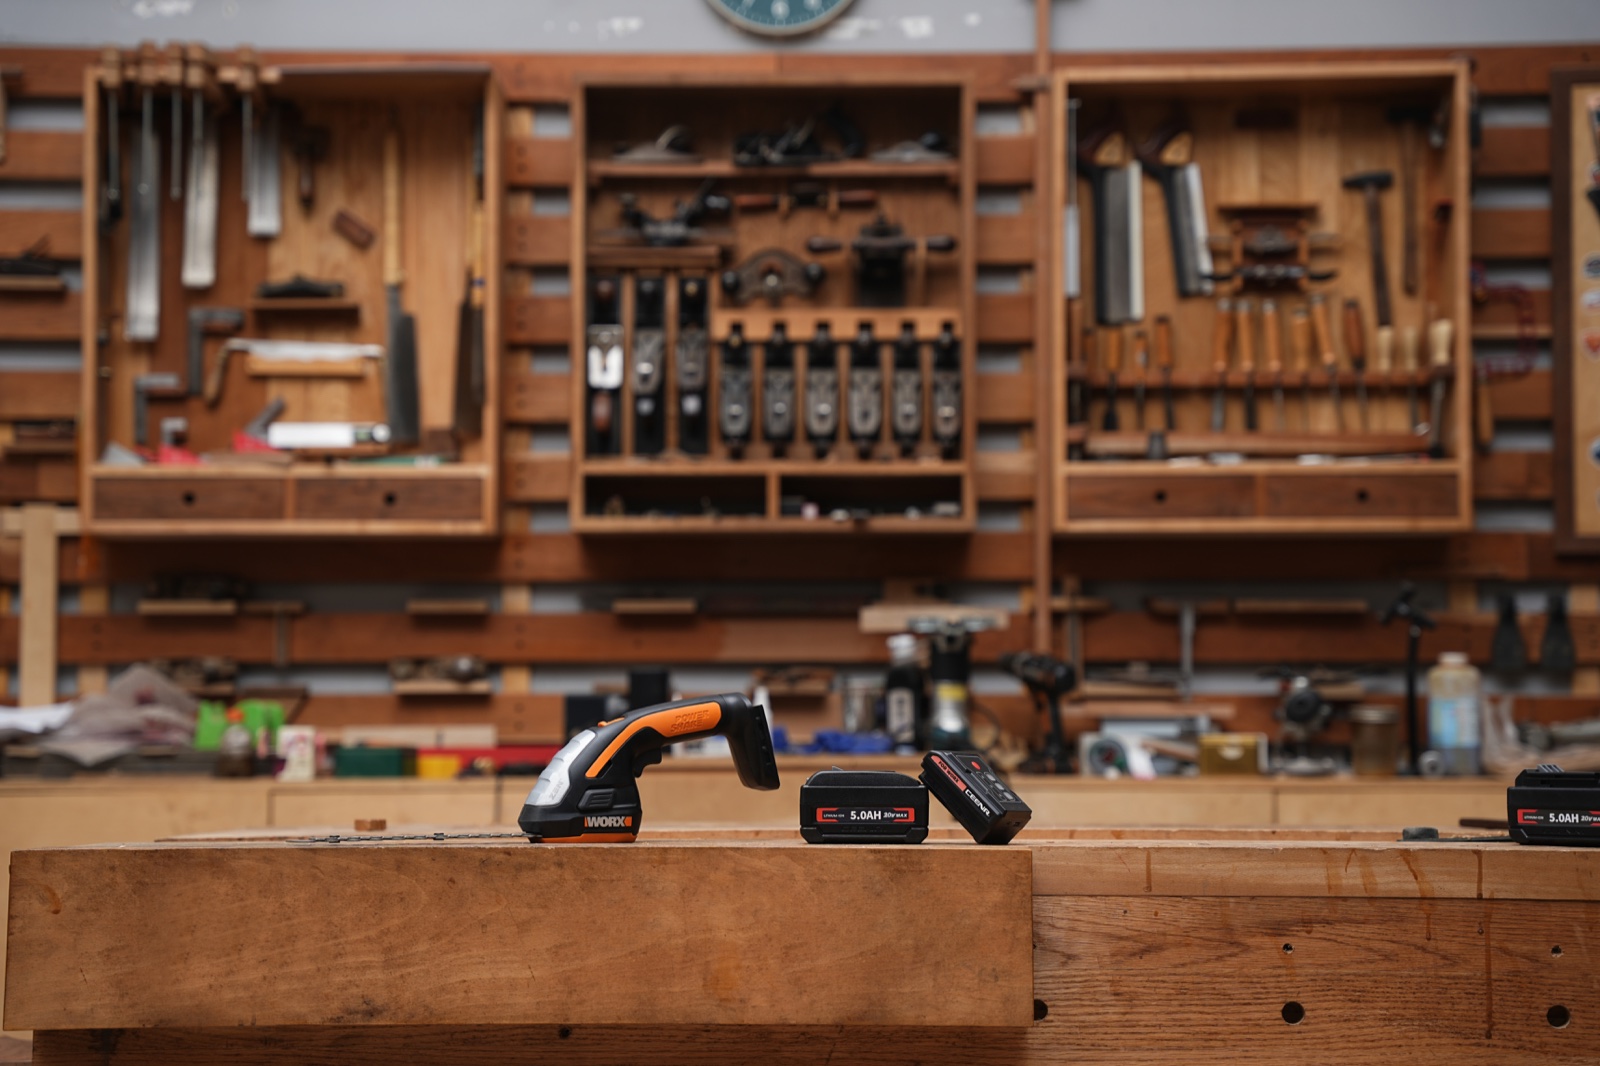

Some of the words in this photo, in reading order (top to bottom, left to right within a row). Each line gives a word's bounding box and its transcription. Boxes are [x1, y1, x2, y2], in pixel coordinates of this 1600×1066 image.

[938, 761, 948, 771] FOR
[850, 810, 882, 820] 5.0AH
[1549, 812, 1579, 823] 5.0AH
[586, 815, 626, 828] WORX
